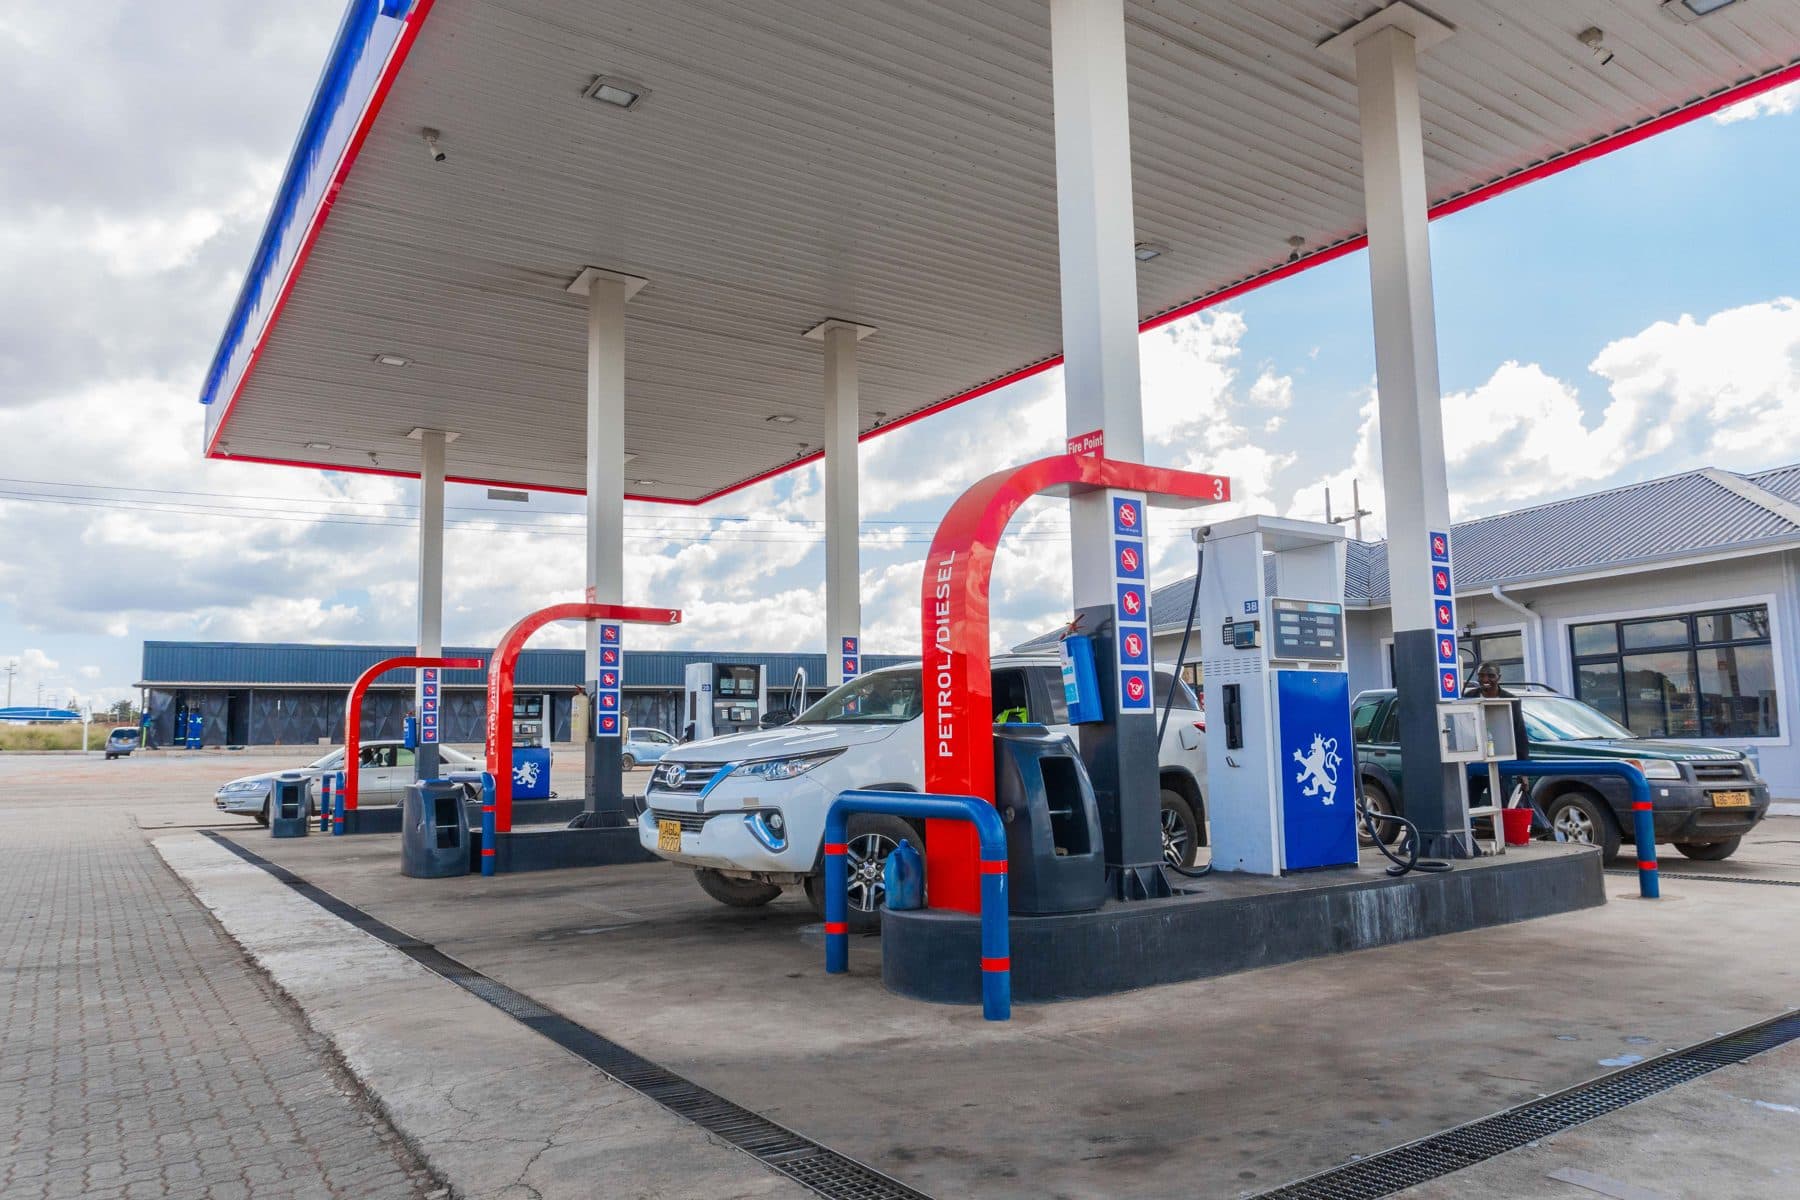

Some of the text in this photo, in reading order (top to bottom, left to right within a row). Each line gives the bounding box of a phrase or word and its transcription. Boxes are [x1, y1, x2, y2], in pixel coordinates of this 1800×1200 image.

[1068, 435, 1103, 454] Fire Point
[1213, 479, 1223, 500] 3
[669, 611, 677, 623] 2
[936, 550, 955, 757] PETROL/DIESEL
[477, 660, 482, 668] 1
